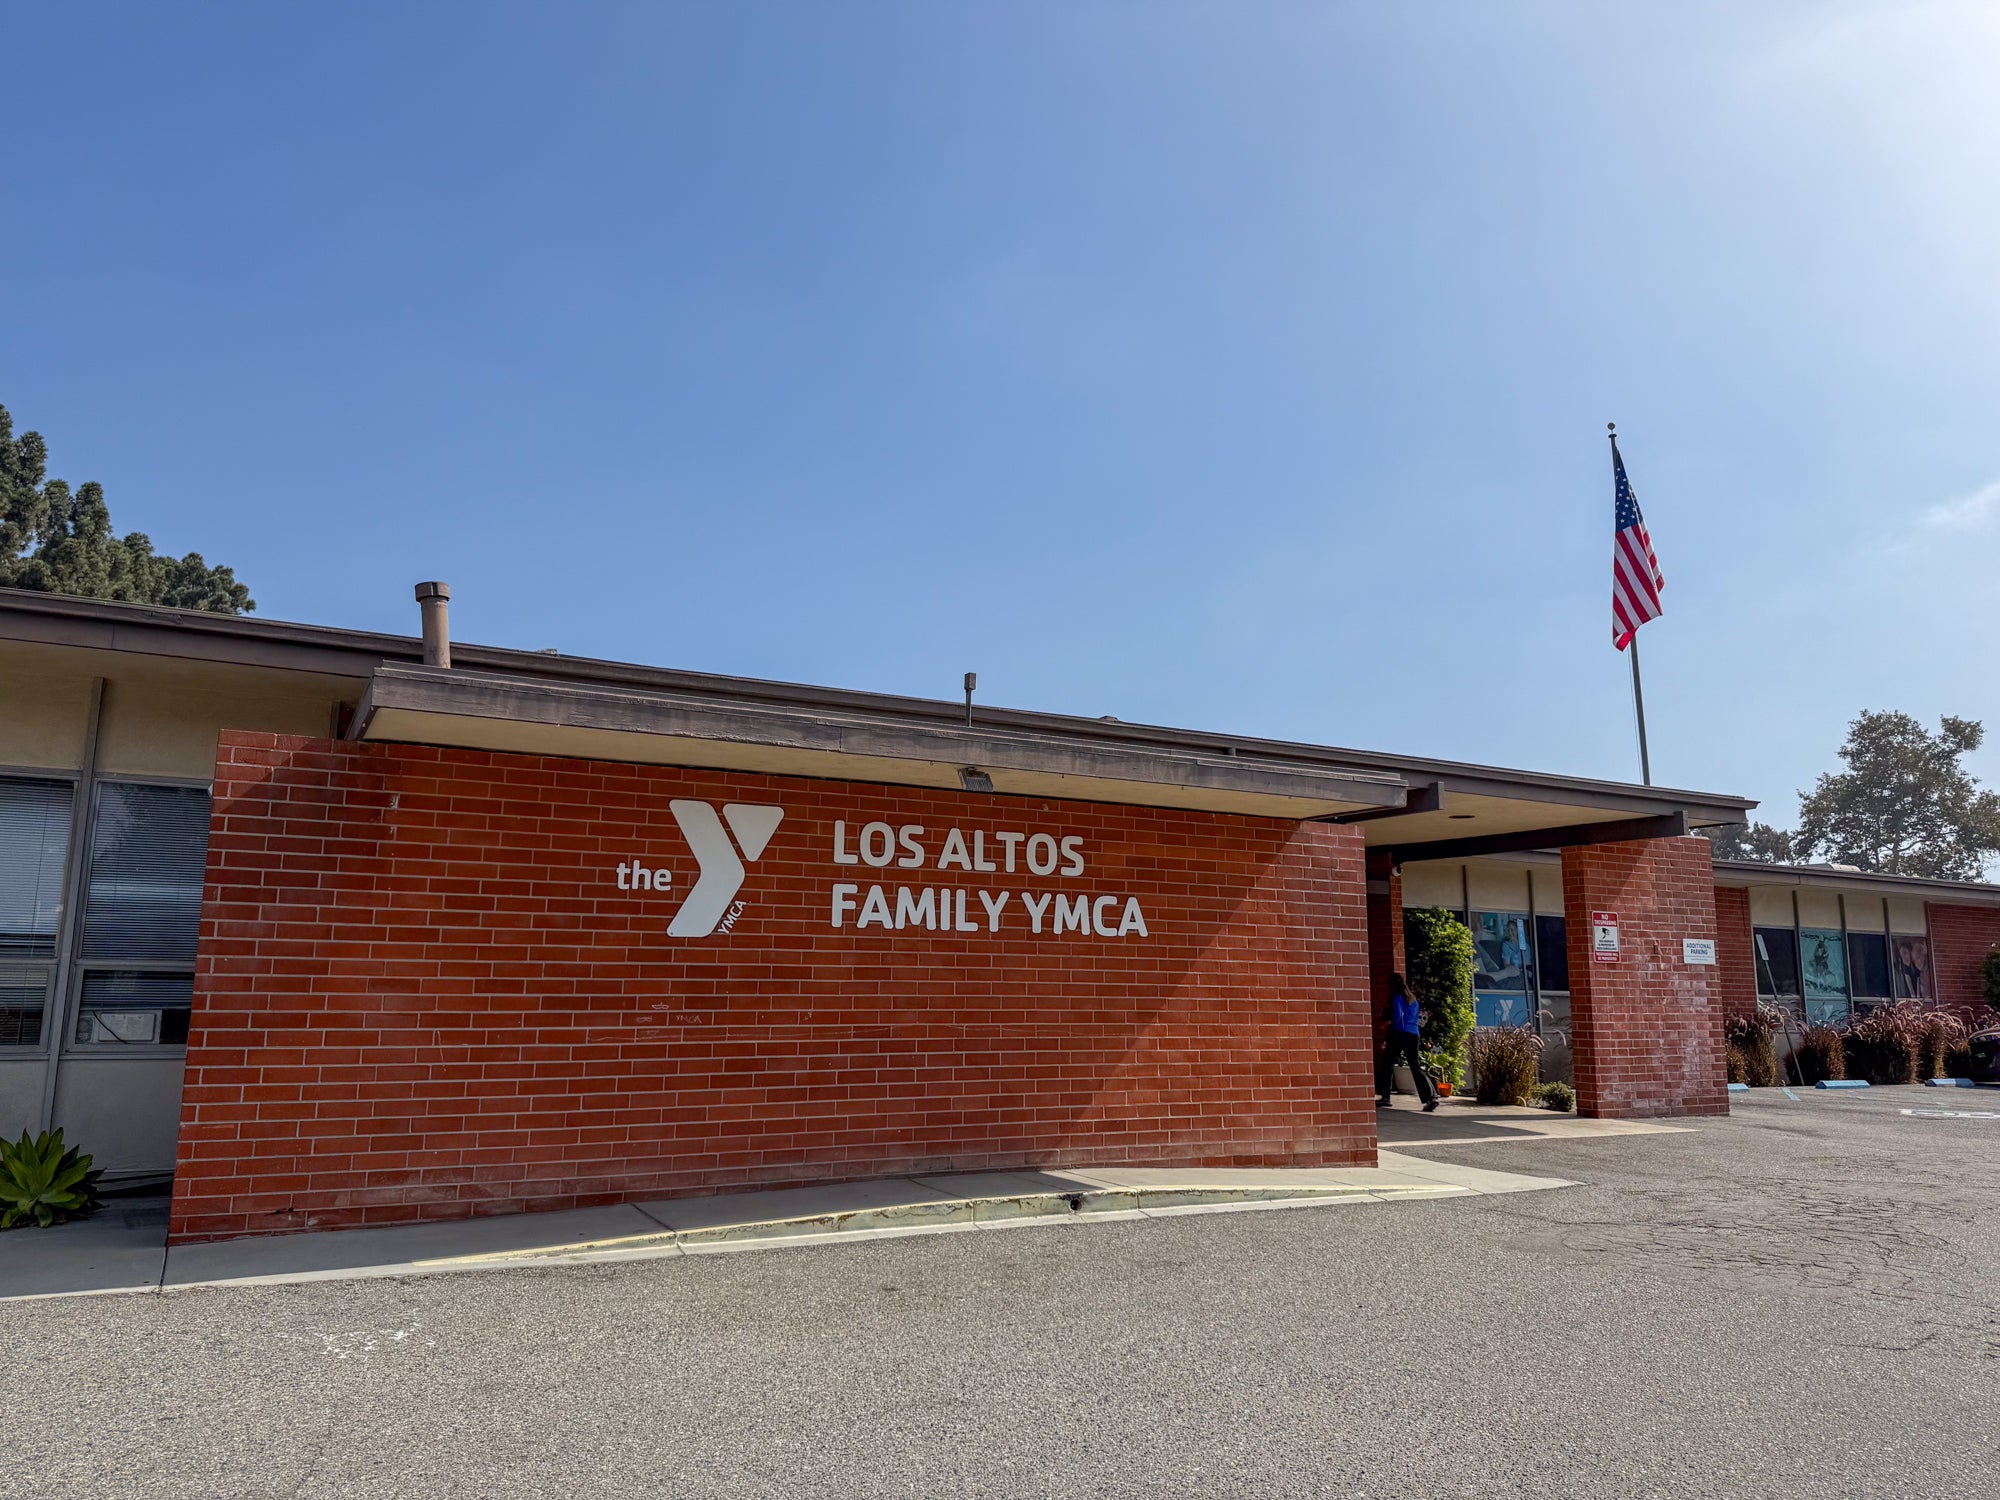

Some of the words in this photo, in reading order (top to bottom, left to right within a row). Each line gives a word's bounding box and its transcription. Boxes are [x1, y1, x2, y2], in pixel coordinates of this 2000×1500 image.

[832, 820, 925, 868] LOS
[937, 828, 1085, 877] ALTOS
[616, 860, 672, 891] the
[717, 900, 747, 935] YMCA
[831, 883, 1010, 933] FAMILY
[1021, 893, 1149, 938] YMCA
